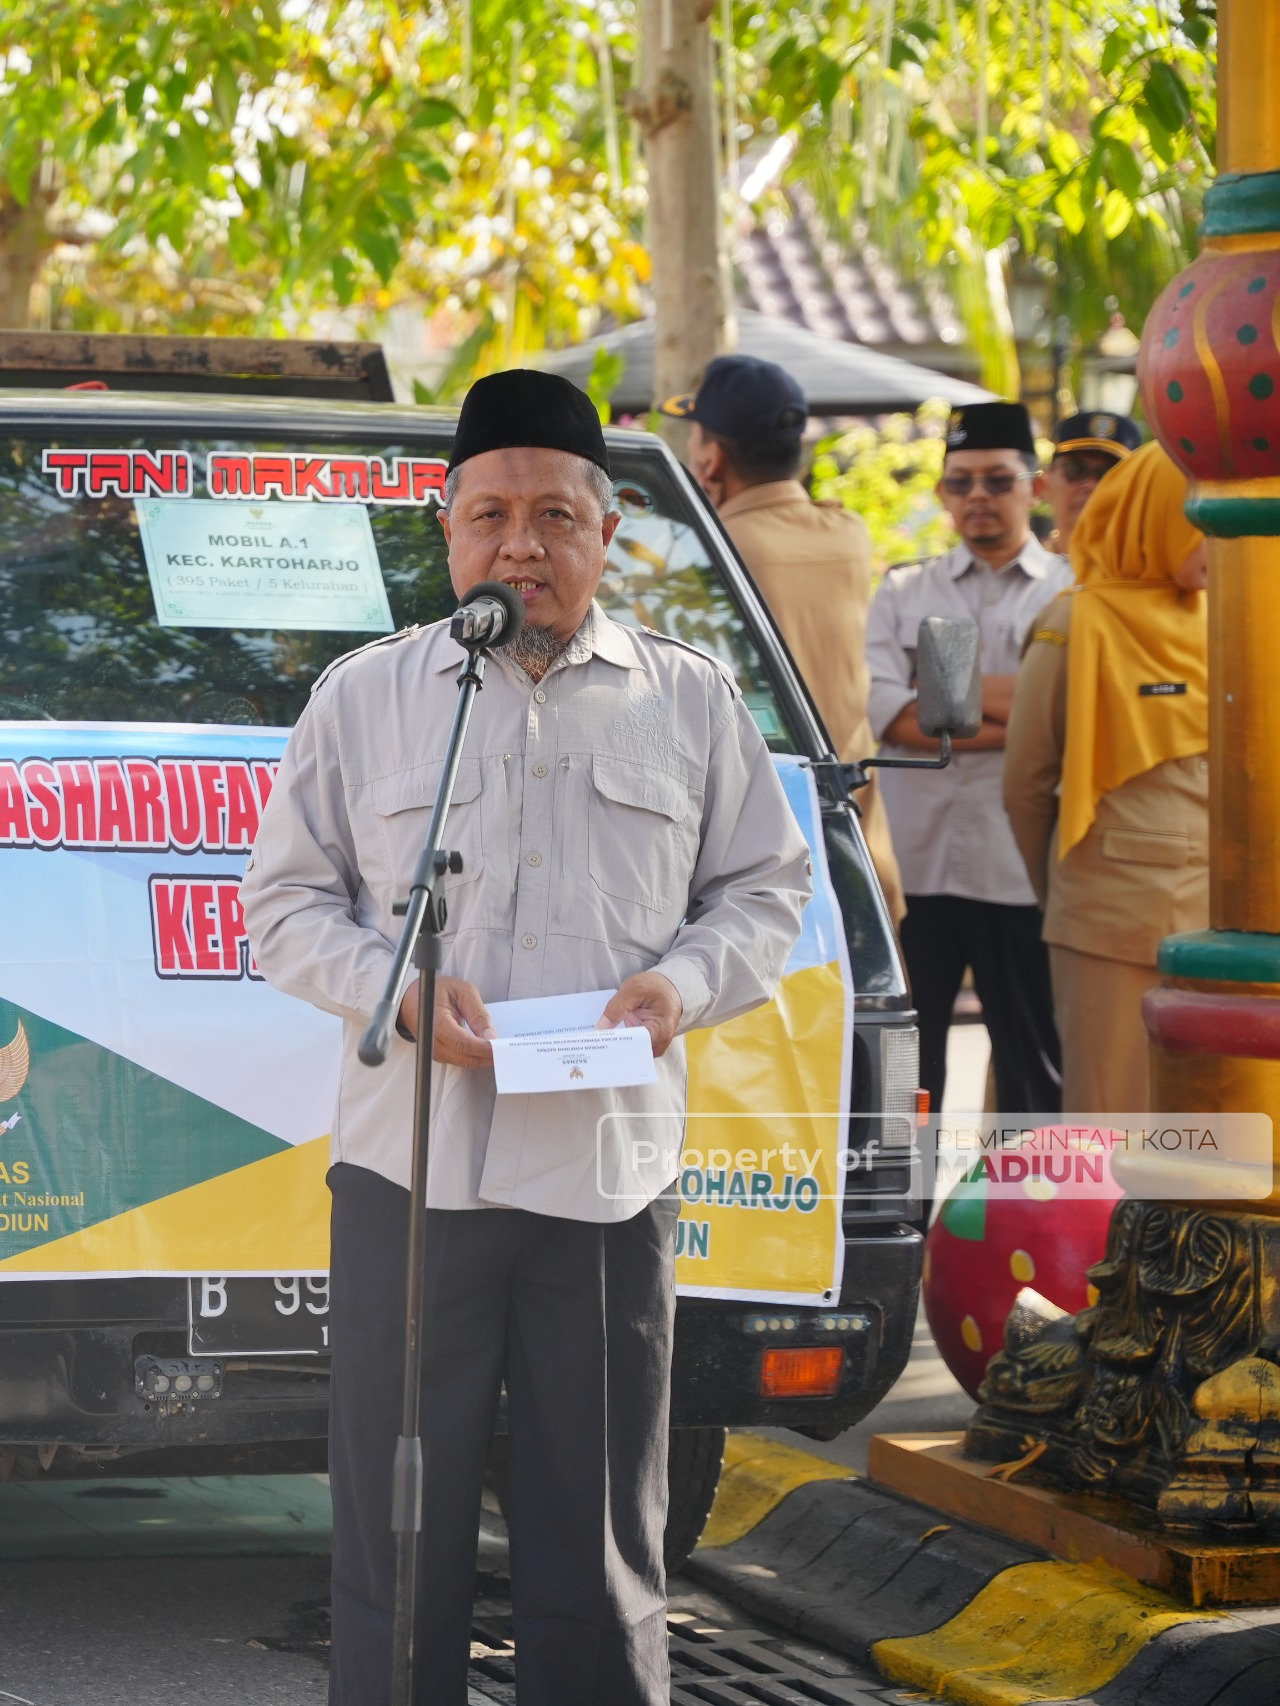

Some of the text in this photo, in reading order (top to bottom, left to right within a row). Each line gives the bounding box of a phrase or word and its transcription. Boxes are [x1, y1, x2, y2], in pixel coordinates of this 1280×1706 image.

[42, 449, 192, 498] TANI
[207, 534, 309, 549] MOBIL A.1
[166, 553, 360, 572] KEC. KARTOHARJO
[176, 576, 205, 587] 395
[209, 577, 250, 589] Paket
[268, 577, 278, 589] 5
[282, 578, 360, 592] Kelurahan
[151, 877, 265, 977] KEP
[14, 1191, 84, 1207] Nasional
[678, 1167, 820, 1214] OHARJO
[200, 1277, 228, 1318] B
